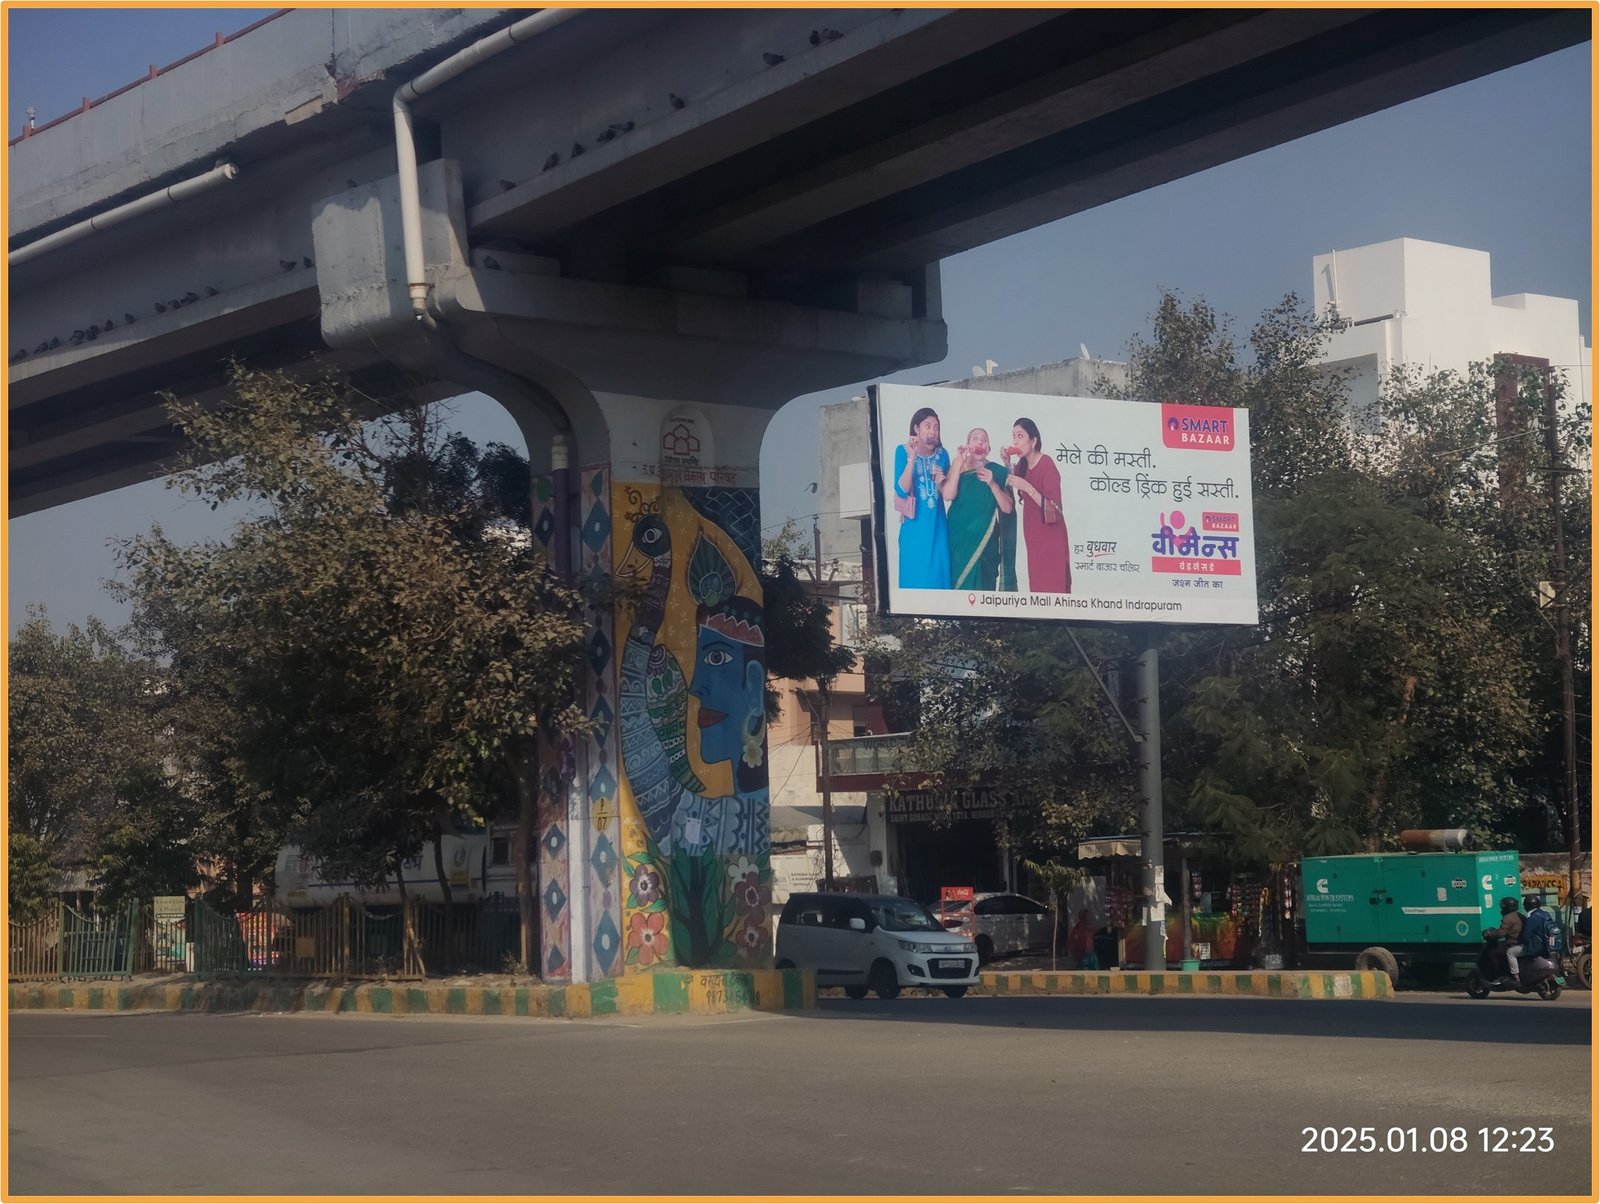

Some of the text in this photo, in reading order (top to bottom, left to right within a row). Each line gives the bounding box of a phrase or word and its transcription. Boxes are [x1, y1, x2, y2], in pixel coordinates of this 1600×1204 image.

[1181, 417, 1228, 433] SMART
[1181, 433, 1230, 445] BAZAAR
[1055, 442, 1156, 469] मेले की मस्ती.
[1089, 471, 1239, 502] कोल्ड ड्रिंक हुई सस्ती.
[1086, 540, 1117, 557] बुधवार
[1193, 577, 1209, 589] जीत
[1211, 580, 1223, 589] का
[980, 594, 1183, 612] Jaipuriya Mall Ahinsa Khand Indrapuram
[597, 816, 608, 831] 07
